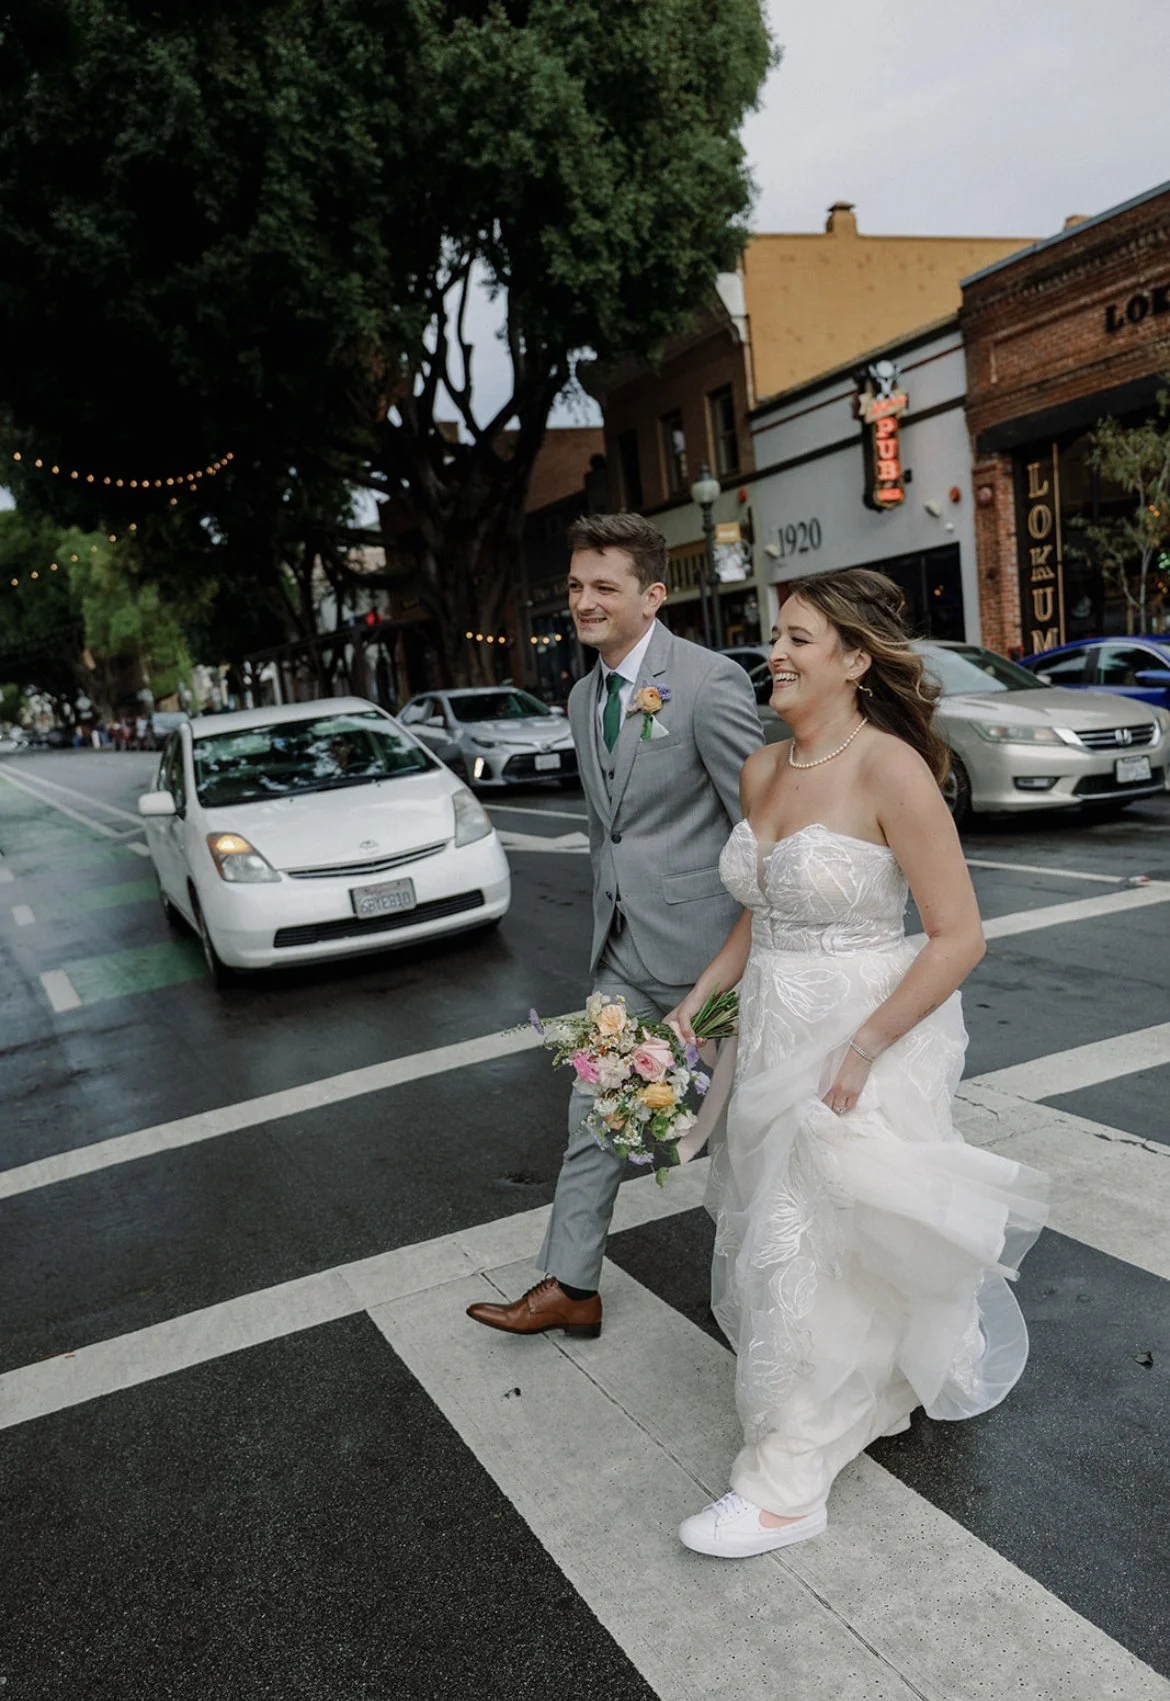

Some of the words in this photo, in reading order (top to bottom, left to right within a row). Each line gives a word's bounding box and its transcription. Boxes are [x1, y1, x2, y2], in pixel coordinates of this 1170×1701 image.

[875, 416, 900, 481] PUB
[778, 517, 822, 557] 1920
[1027, 462, 1059, 656] LOKUM
